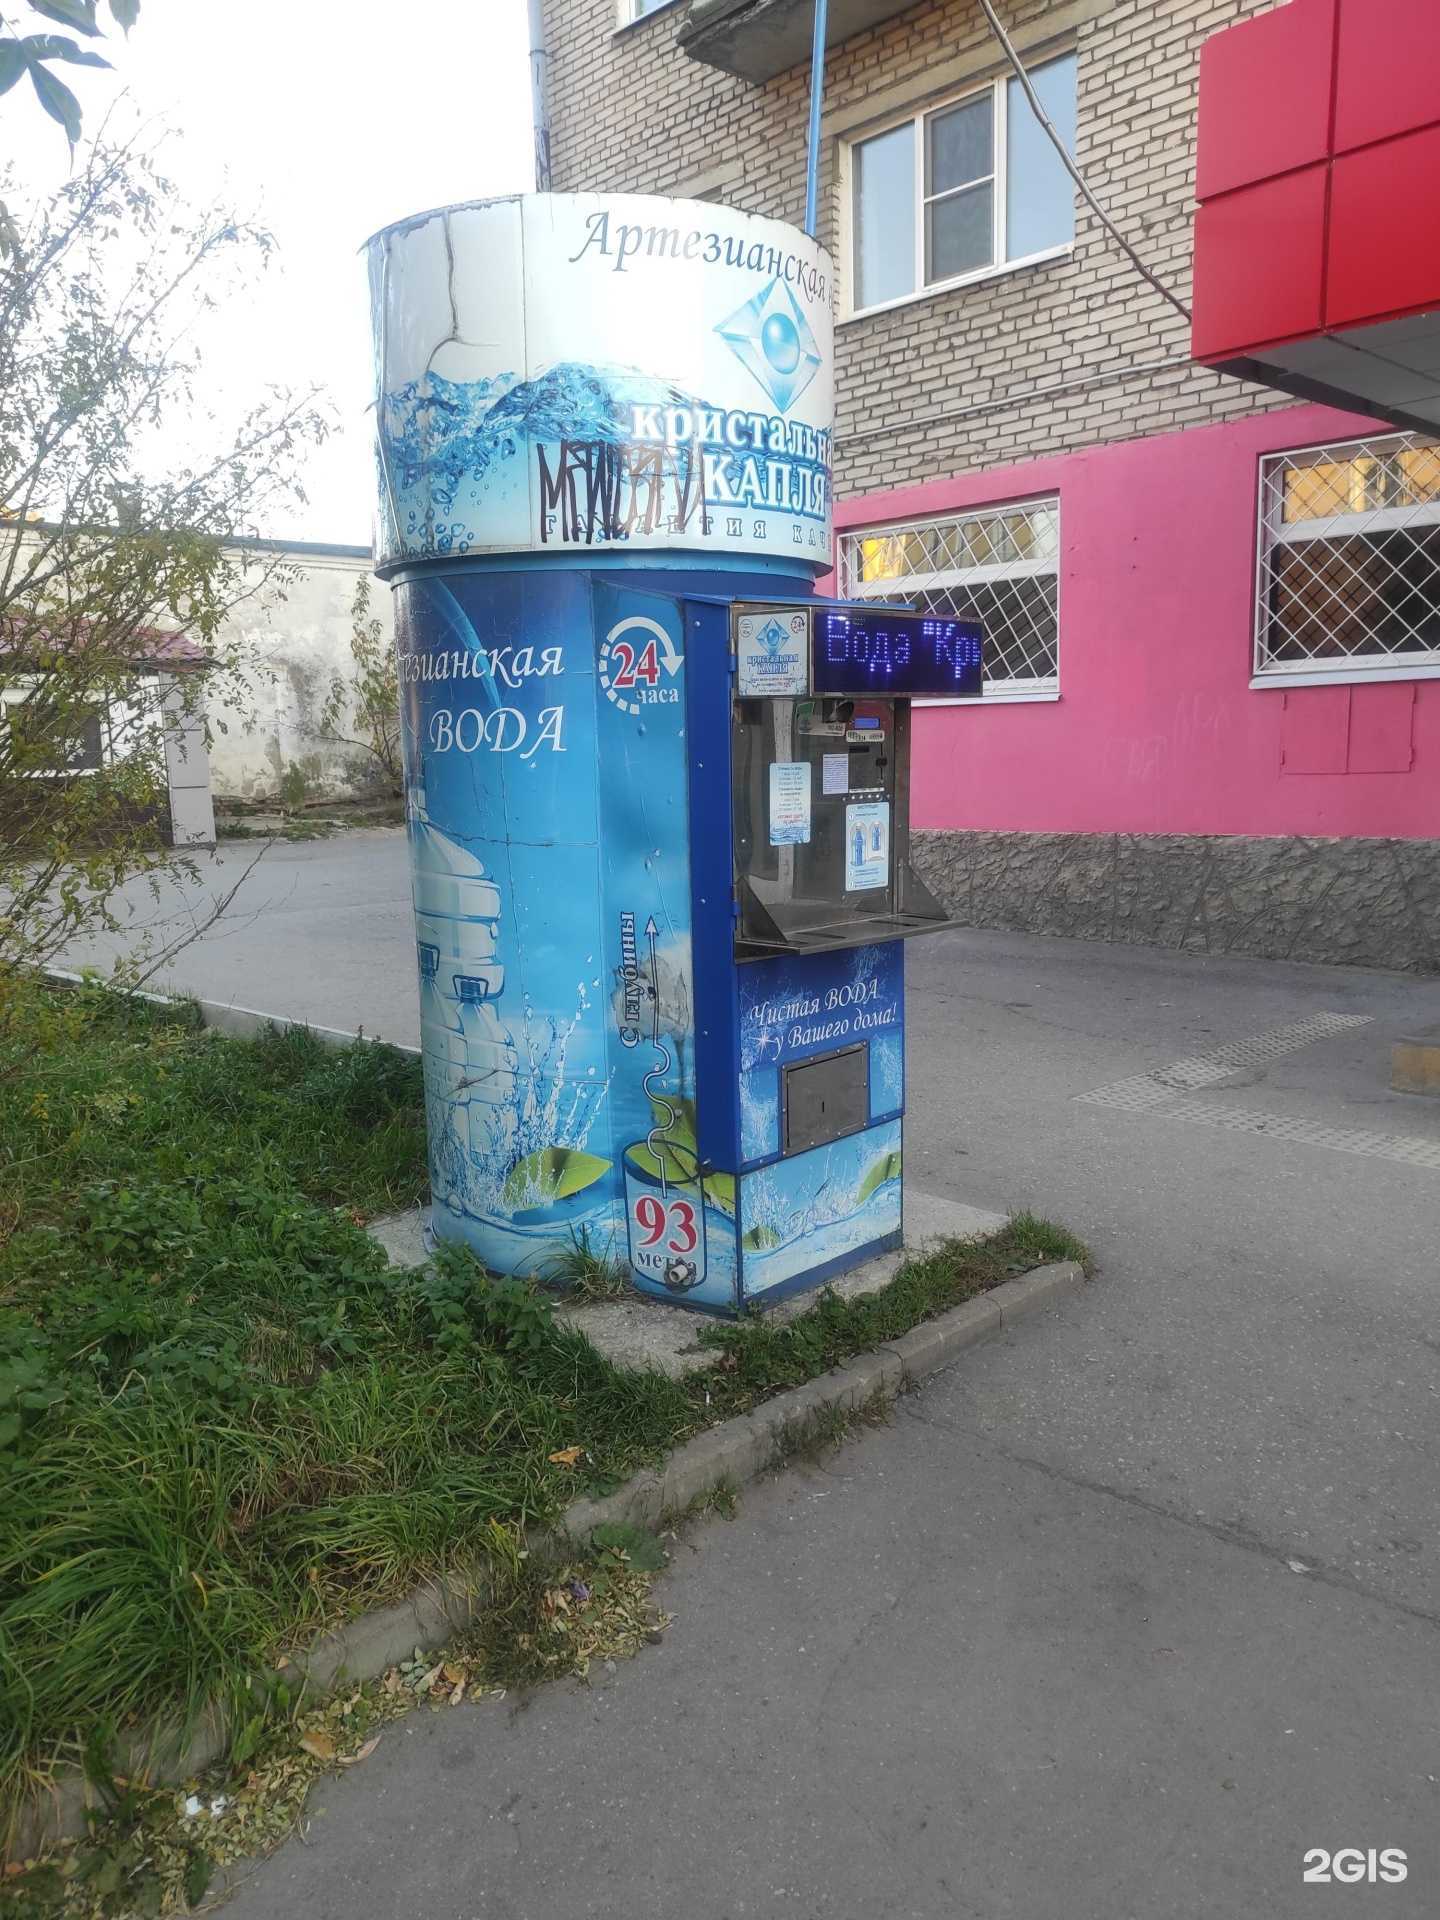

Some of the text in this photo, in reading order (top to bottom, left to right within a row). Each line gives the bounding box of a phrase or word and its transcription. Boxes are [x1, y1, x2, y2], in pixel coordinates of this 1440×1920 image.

[568, 210, 826, 303] Артезианская
[702, 451, 826, 522] КАПЛЯ
[611, 640, 660, 688] 24
[827, 615, 911, 673] Вода
[636, 688, 679, 704] часа
[430, 705, 567, 759] ВОДА
[618, 911, 645, 1049] С глубины
[750, 976, 881, 1026] Чистая ВОДА
[771, 1001, 897, 1061] у Вашего дома!
[634, 1194, 698, 1255] 93
[637, 1252, 697, 1279] мета
